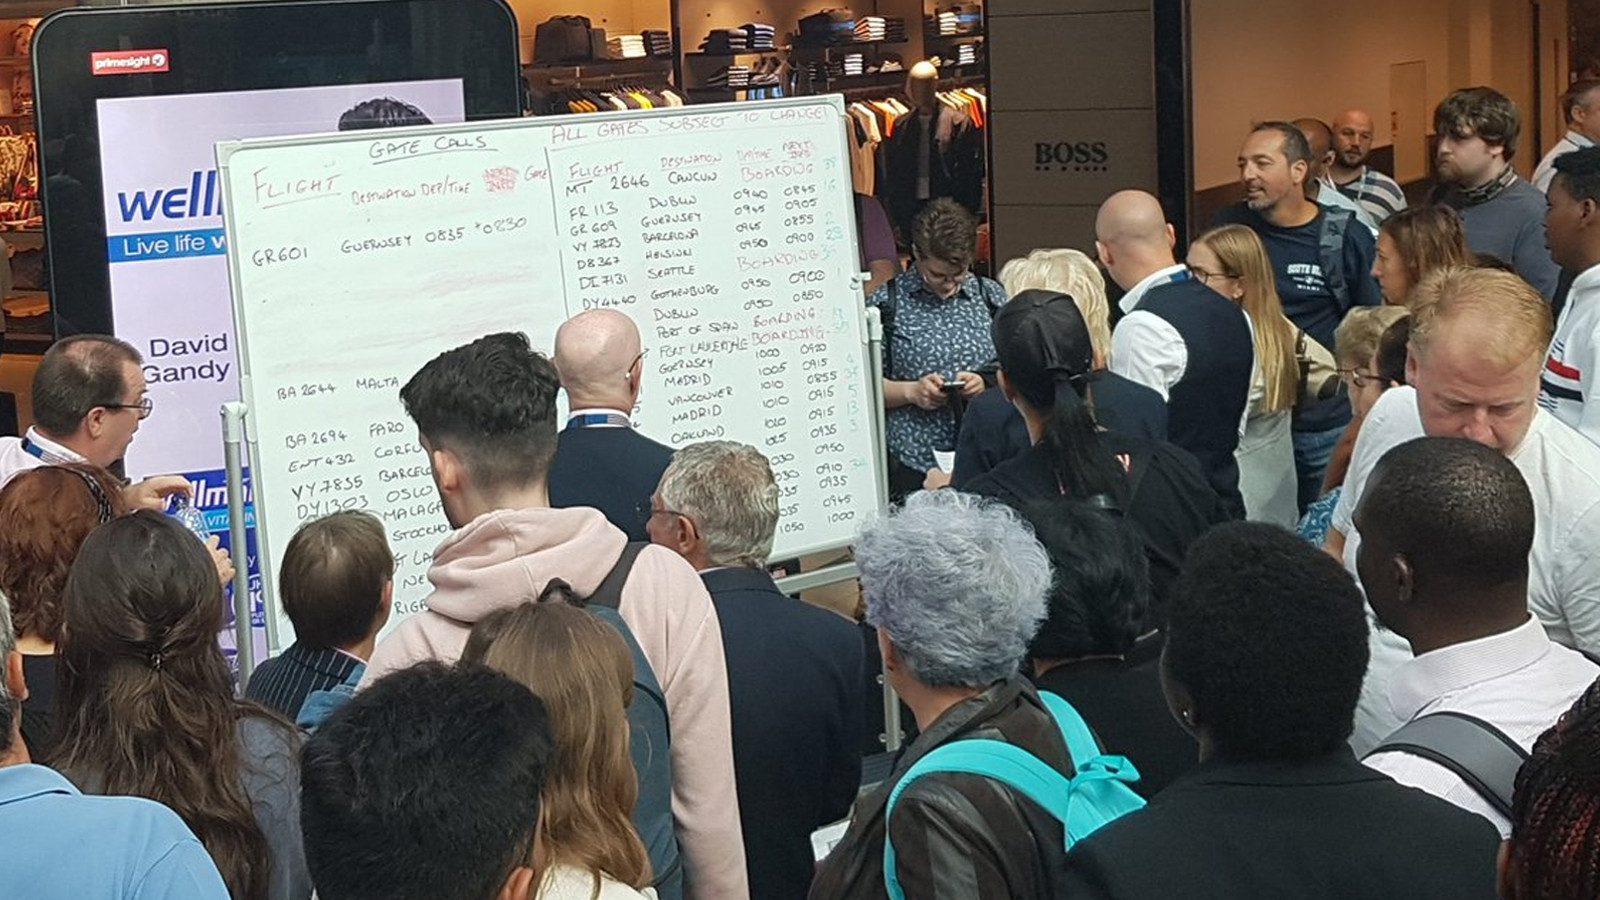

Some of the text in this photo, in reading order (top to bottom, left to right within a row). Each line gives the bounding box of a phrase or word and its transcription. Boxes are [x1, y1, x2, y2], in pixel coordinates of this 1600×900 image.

[95, 56, 150, 70] primesight
[552, 123, 587, 144] ALL
[597, 121, 649, 137] GATES
[659, 116, 728, 133] SUBJECT
[369, 135, 487, 158] GATE CALLS
[1035, 142, 1108, 164] BOSS
[566, 180, 593, 197] MT
[610, 174, 650, 190] 2646
[667, 171, 718, 185] CANCUN
[740, 162, 814, 183] BOARDING
[569, 161, 624, 179] FLIGHT
[117, 170, 222, 222] well
[253, 167, 342, 203] FLIGHT
[351, 187, 416, 206] DESTINATION
[569, 205, 589, 221] FR
[594, 201, 619, 217] 113
[733, 188, 769, 200] 0940
[783, 184, 816, 197] 0845
[641, 212, 702, 228] GUERNSEY
[784, 198, 818, 210] 0905
[124, 238, 169, 256] Live
[175, 234, 205, 252] life
[252, 247, 308, 267] GR601
[341, 235, 412, 254] GUERNSEY
[425, 227, 464, 243] 0835
[641, 228, 699, 244] BARCELONA
[739, 238, 768, 250] 0950
[785, 232, 815, 245] 0900
[647, 265, 696, 279] SEATTLE
[736, 249, 819, 272] BOARDING
[650, 284, 720, 300] GOTHENBURG
[741, 278, 771, 290] 0950
[788, 270, 826, 284] 0900
[743, 300, 773, 311] 0950
[792, 290, 824, 303] 0850
[656, 326, 682, 339] PORT
[689, 325, 701, 335] OF
[150, 333, 228, 358] David
[660, 345, 686, 358] FORT
[756, 348, 780, 358] 1000
[142, 361, 230, 384] Gandy
[664, 373, 711, 387] MADRID
[759, 362, 787, 376] 1005
[802, 358, 828, 370] 0915
[277, 377, 399, 400] BA 2644 MALTA
[668, 386, 733, 406] VANCOUVER
[807, 371, 837, 384] 0855
[672, 404, 722, 424] MADRID
[763, 396, 789, 408] 1010
[808, 385, 834, 401] 0915
[808, 406, 835, 420] 0915
[285, 421, 404, 449] BA 2694 FARO
[810, 424, 837, 438] 0935
[374, 443, 421, 458] CORFU
[771, 443, 845, 465] 030 0950
[378, 466, 432, 481] BARCELO
[775, 470, 800, 481] 030
[816, 463, 843, 474] 0910
[386, 485, 432, 502] OSLO
[778, 476, 848, 497] 035 0935
[780, 503, 799, 517] 035
[393, 524, 448, 541] STOCKHO
[780, 511, 855, 533] 1050 1000
